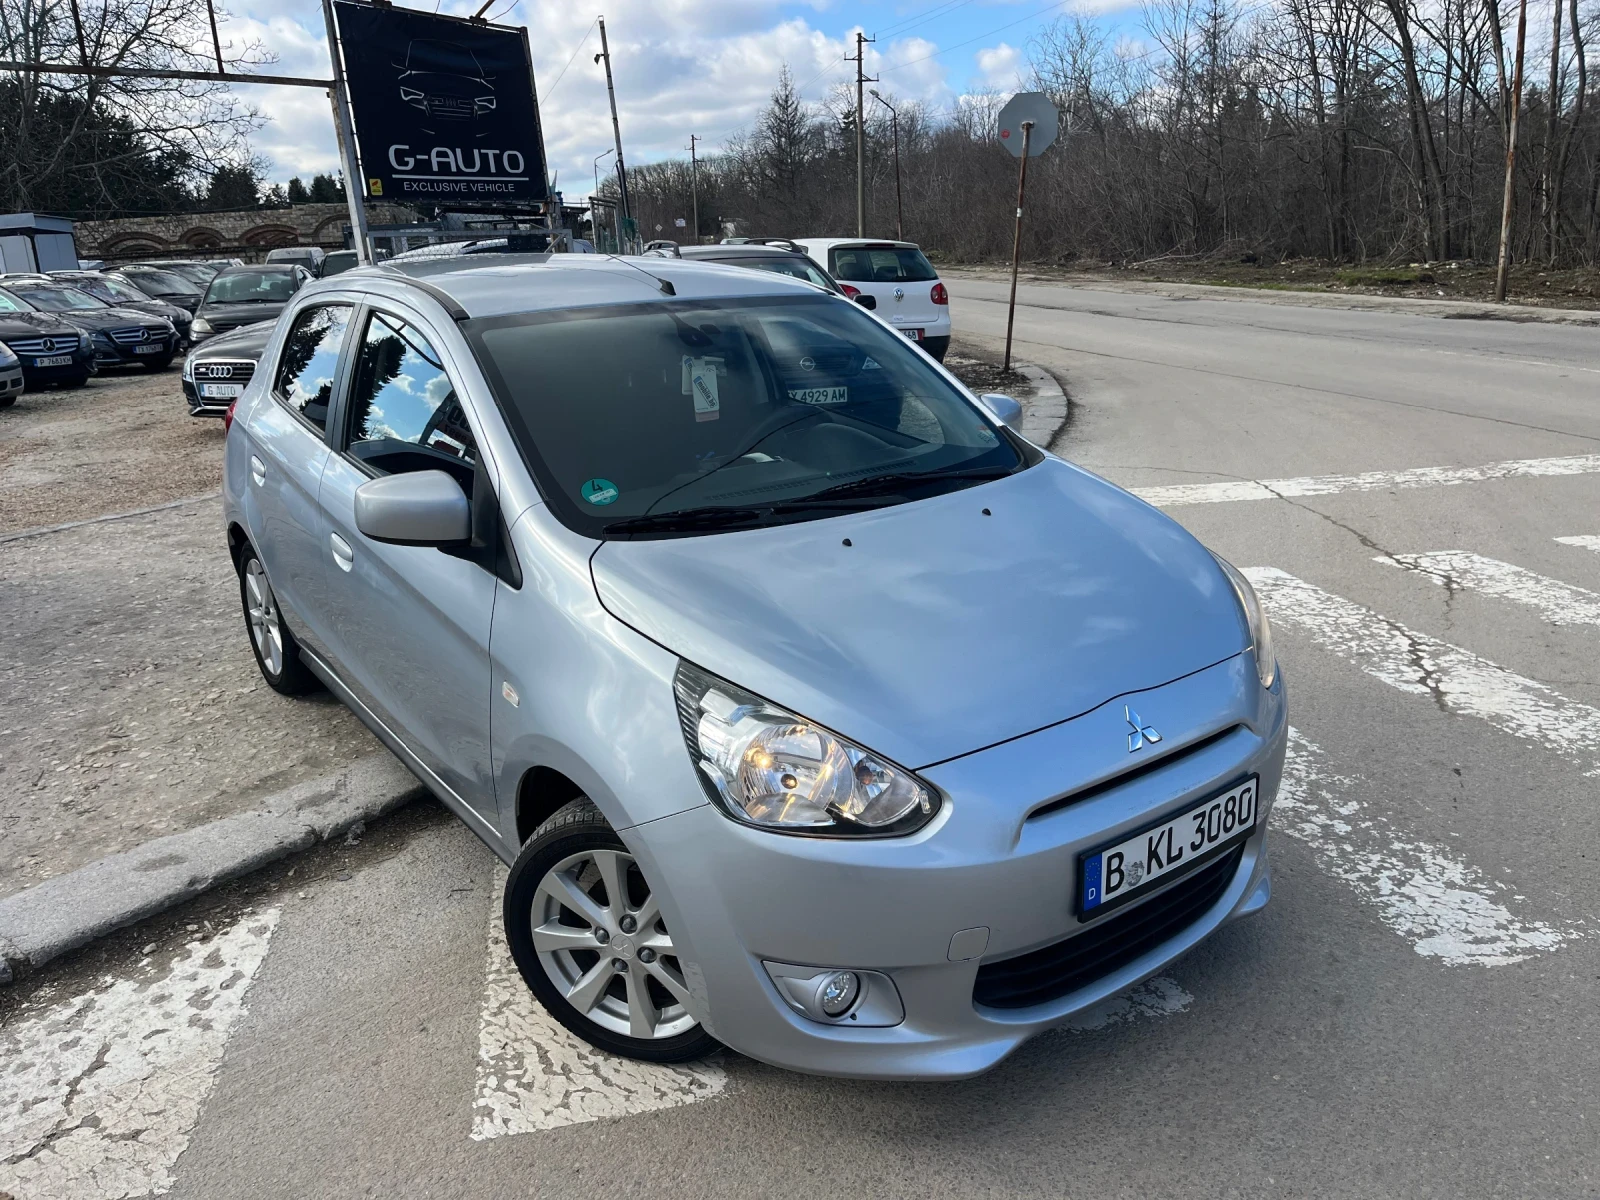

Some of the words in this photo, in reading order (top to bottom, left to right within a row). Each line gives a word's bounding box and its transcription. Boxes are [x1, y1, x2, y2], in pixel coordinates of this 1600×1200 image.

[388, 144, 525, 174] G-AUTO
[403, 181, 468, 192] EXCLUSIVE
[470, 183, 515, 192] VEHICLE
[216, 385, 236, 396] AUTO
[800, 390, 829, 403] 4929
[831, 388, 846, 402] AM
[1104, 851, 1125, 896] B
[1146, 827, 1183, 875] KL
[1190, 787, 1252, 852] 3080
[1088, 887, 1096, 901] D
